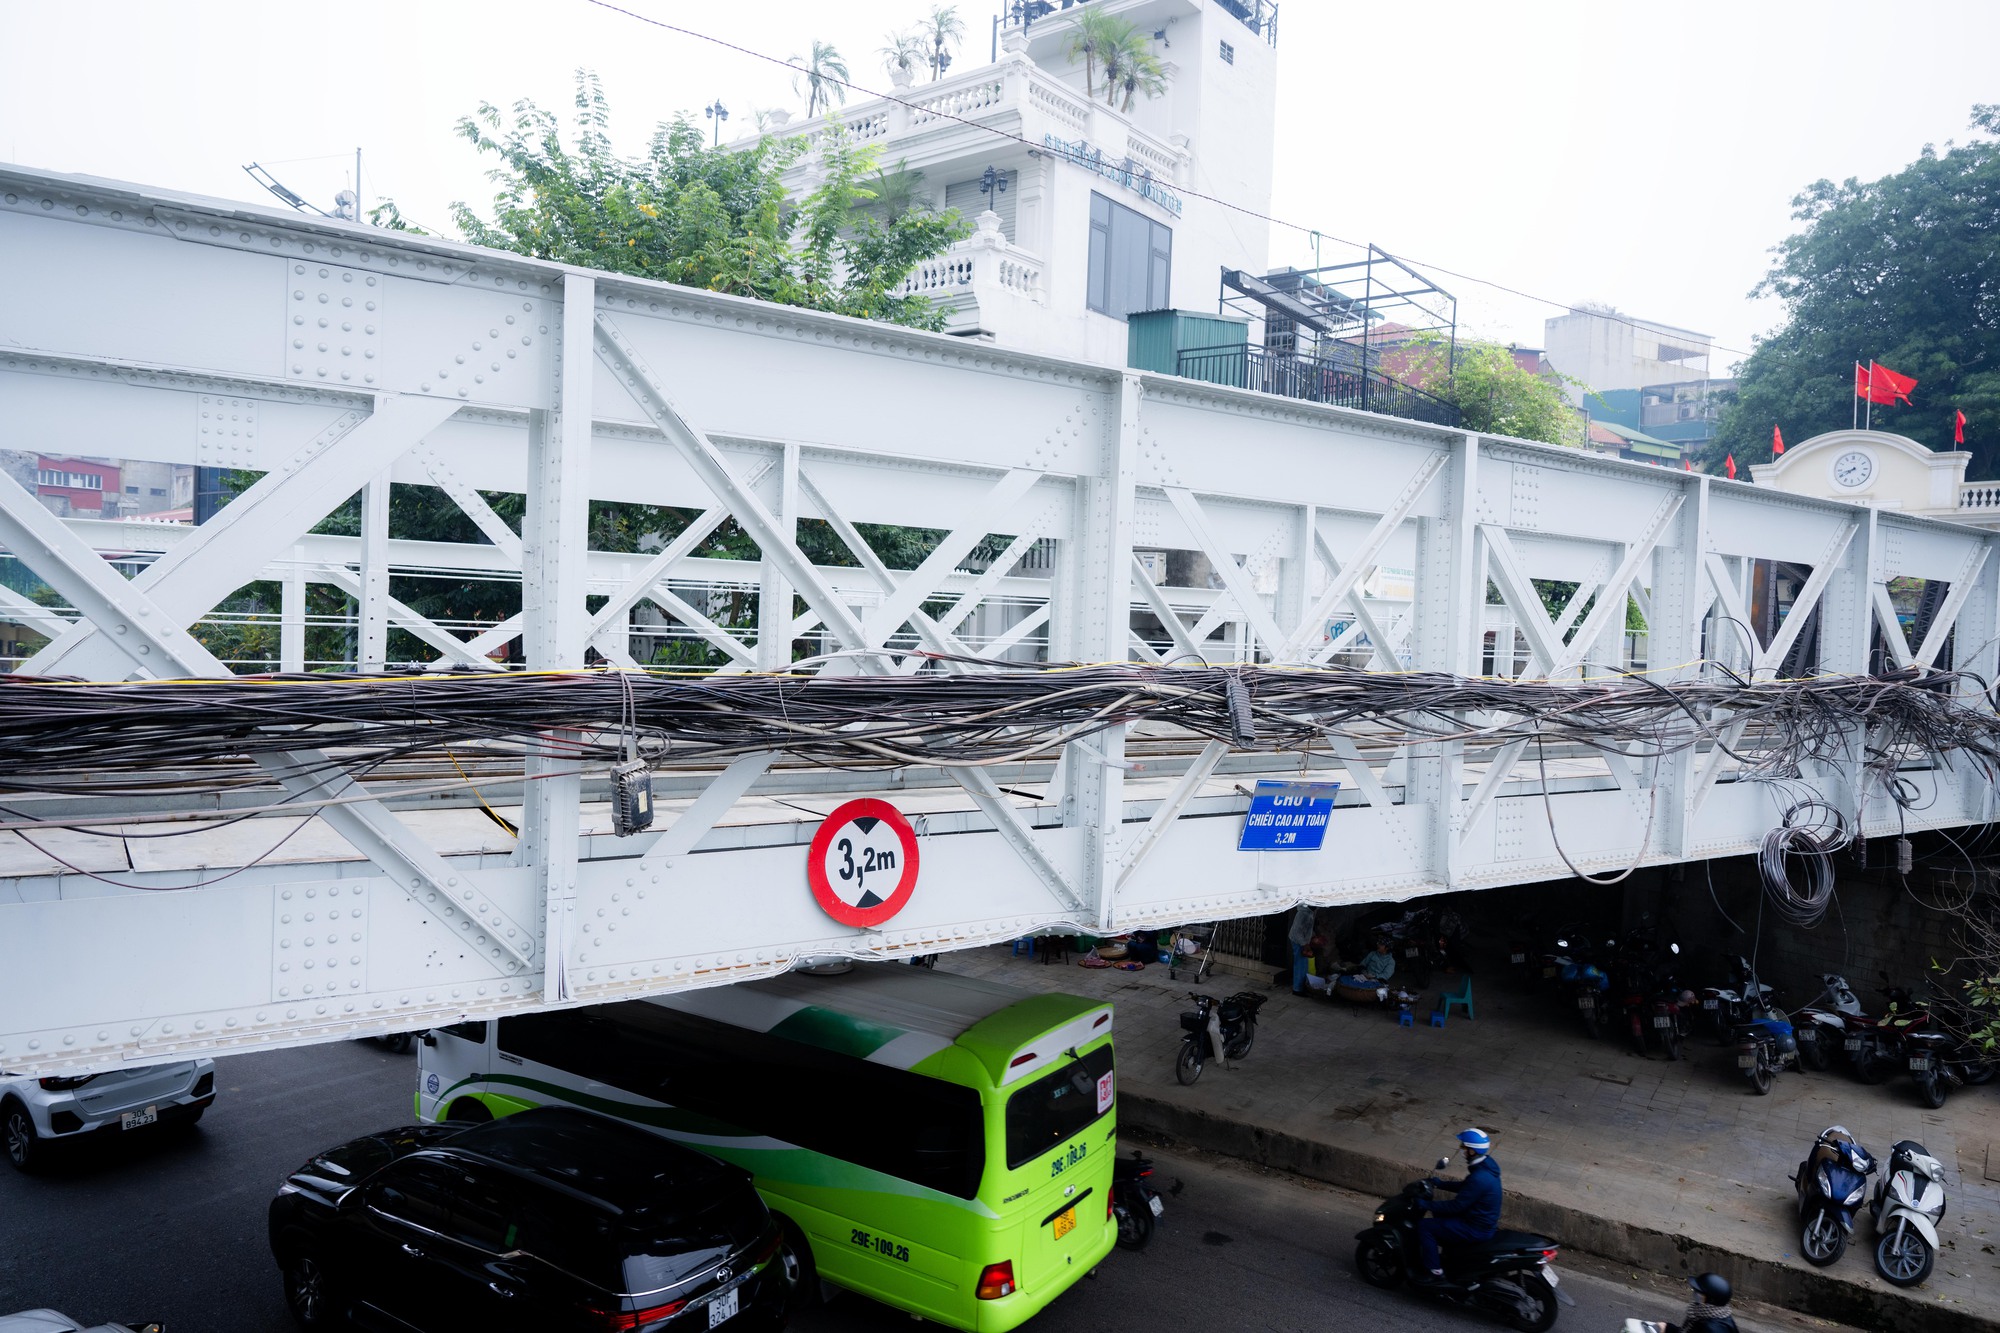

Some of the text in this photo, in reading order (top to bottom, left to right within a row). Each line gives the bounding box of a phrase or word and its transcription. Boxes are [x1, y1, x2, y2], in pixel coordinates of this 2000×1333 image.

[1138, 178, 1182, 213] LOUNGE
[1275, 814, 1293, 827] CAO
[1292, 814, 1305, 827] AN
[1274, 832, 1297, 845] 3,2M
[838, 838, 896, 889] 3,2m
[131, 1108, 147, 1119] 30K
[850, 1228, 910, 1263] 29E-109.26
